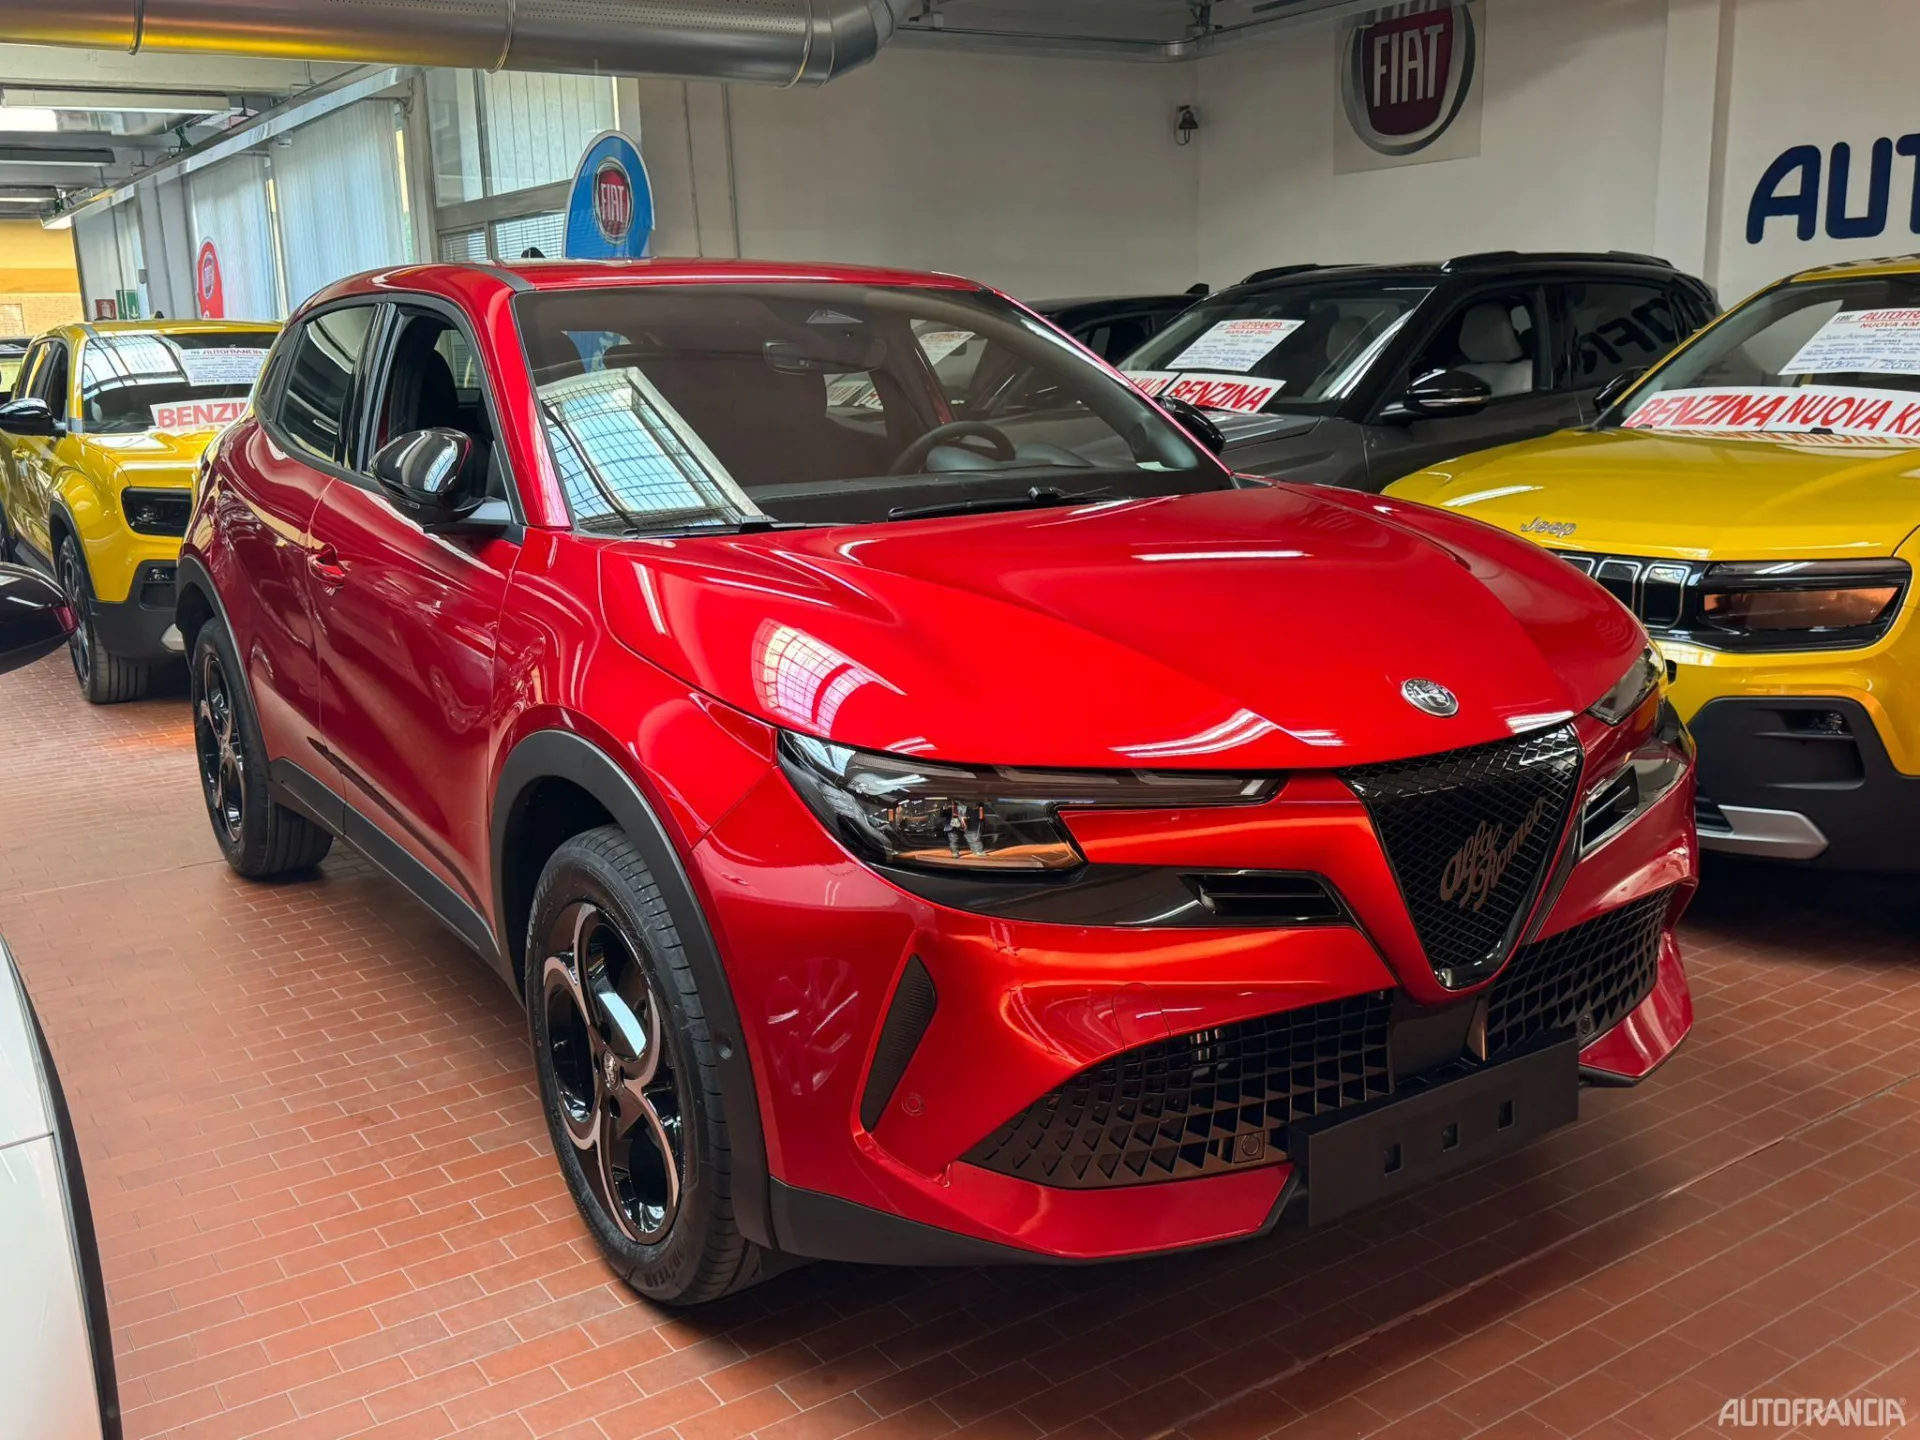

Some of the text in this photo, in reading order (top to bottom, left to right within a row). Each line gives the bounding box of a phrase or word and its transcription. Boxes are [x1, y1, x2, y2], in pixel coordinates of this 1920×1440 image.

[1373, 23, 1444, 107] FIAT
[600, 183, 625, 222] FIAT
[1169, 380, 1273, 411] BENZINA
[1625, 395, 1788, 428] BENZINA
[1776, 394, 1893, 430] NUOVA
[1520, 516, 1577, 538] Jeep
